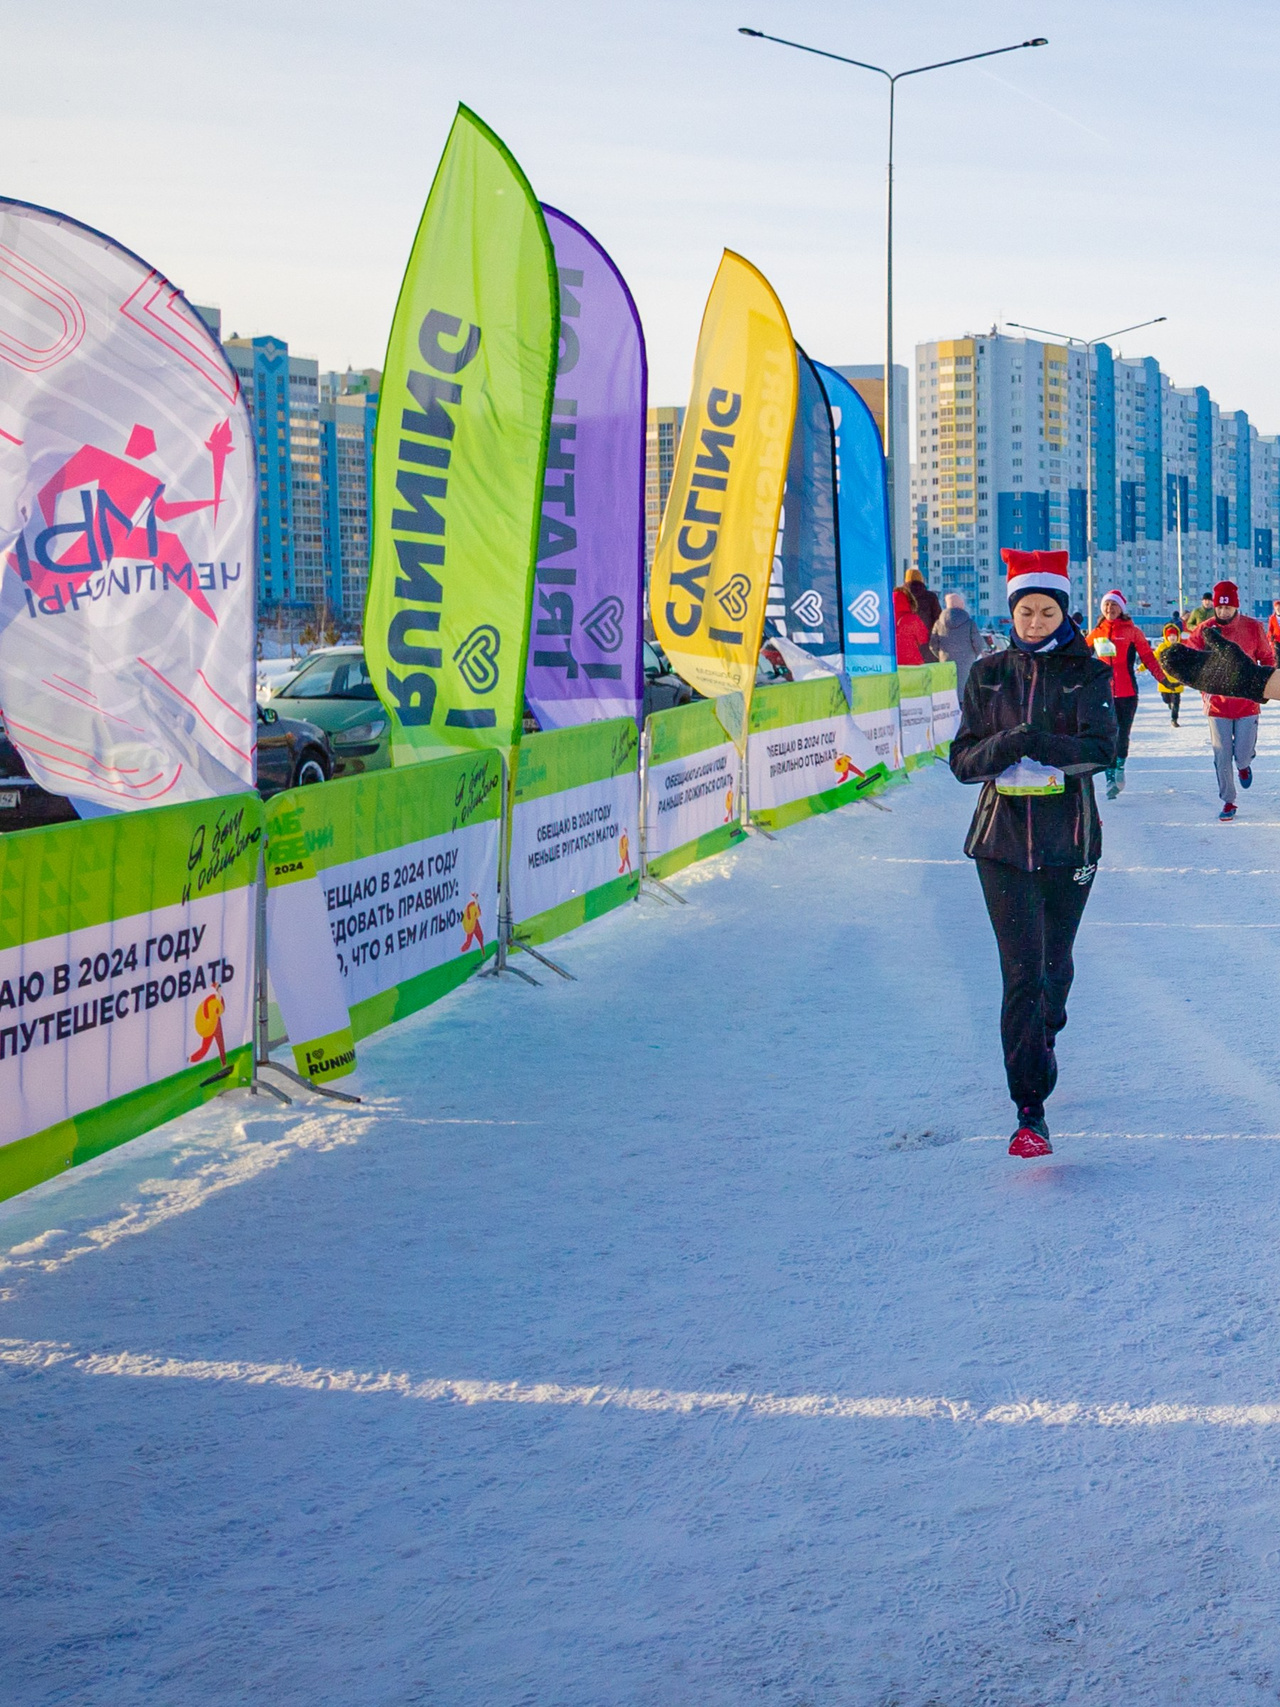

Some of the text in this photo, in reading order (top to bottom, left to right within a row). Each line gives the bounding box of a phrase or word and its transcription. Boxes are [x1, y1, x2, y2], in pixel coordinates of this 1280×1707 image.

[537, 817, 570, 843] ОБЕЩАЮ
[578, 811, 594, 828] 2024
[594, 804, 612, 823] ГОДУ
[188, 824, 205, 871] Я
[274, 861, 304, 875] 2024
[528, 840, 561, 870] МЕНЬШЕ
[562, 831, 595, 861] РУГАТЬСЯ
[182, 883, 191, 906] и
[324, 848, 458, 911] ЕЩАЮ В 2024 ГОДУ
[330, 878, 459, 946] ДОВАТЬ ПРАВИЛУ:
[53, 963, 70, 995] В
[78, 943, 138, 988] 2024
[145, 924, 207, 968] ГОДУ
[352, 941, 380, 967] ЧТО
[385, 938, 394, 956] Я
[399, 926, 416, 951] ЕМ
[419, 924, 427, 941] И
[0, 958, 234, 1060] ПУТЕШЕСТВОВАТЬ
